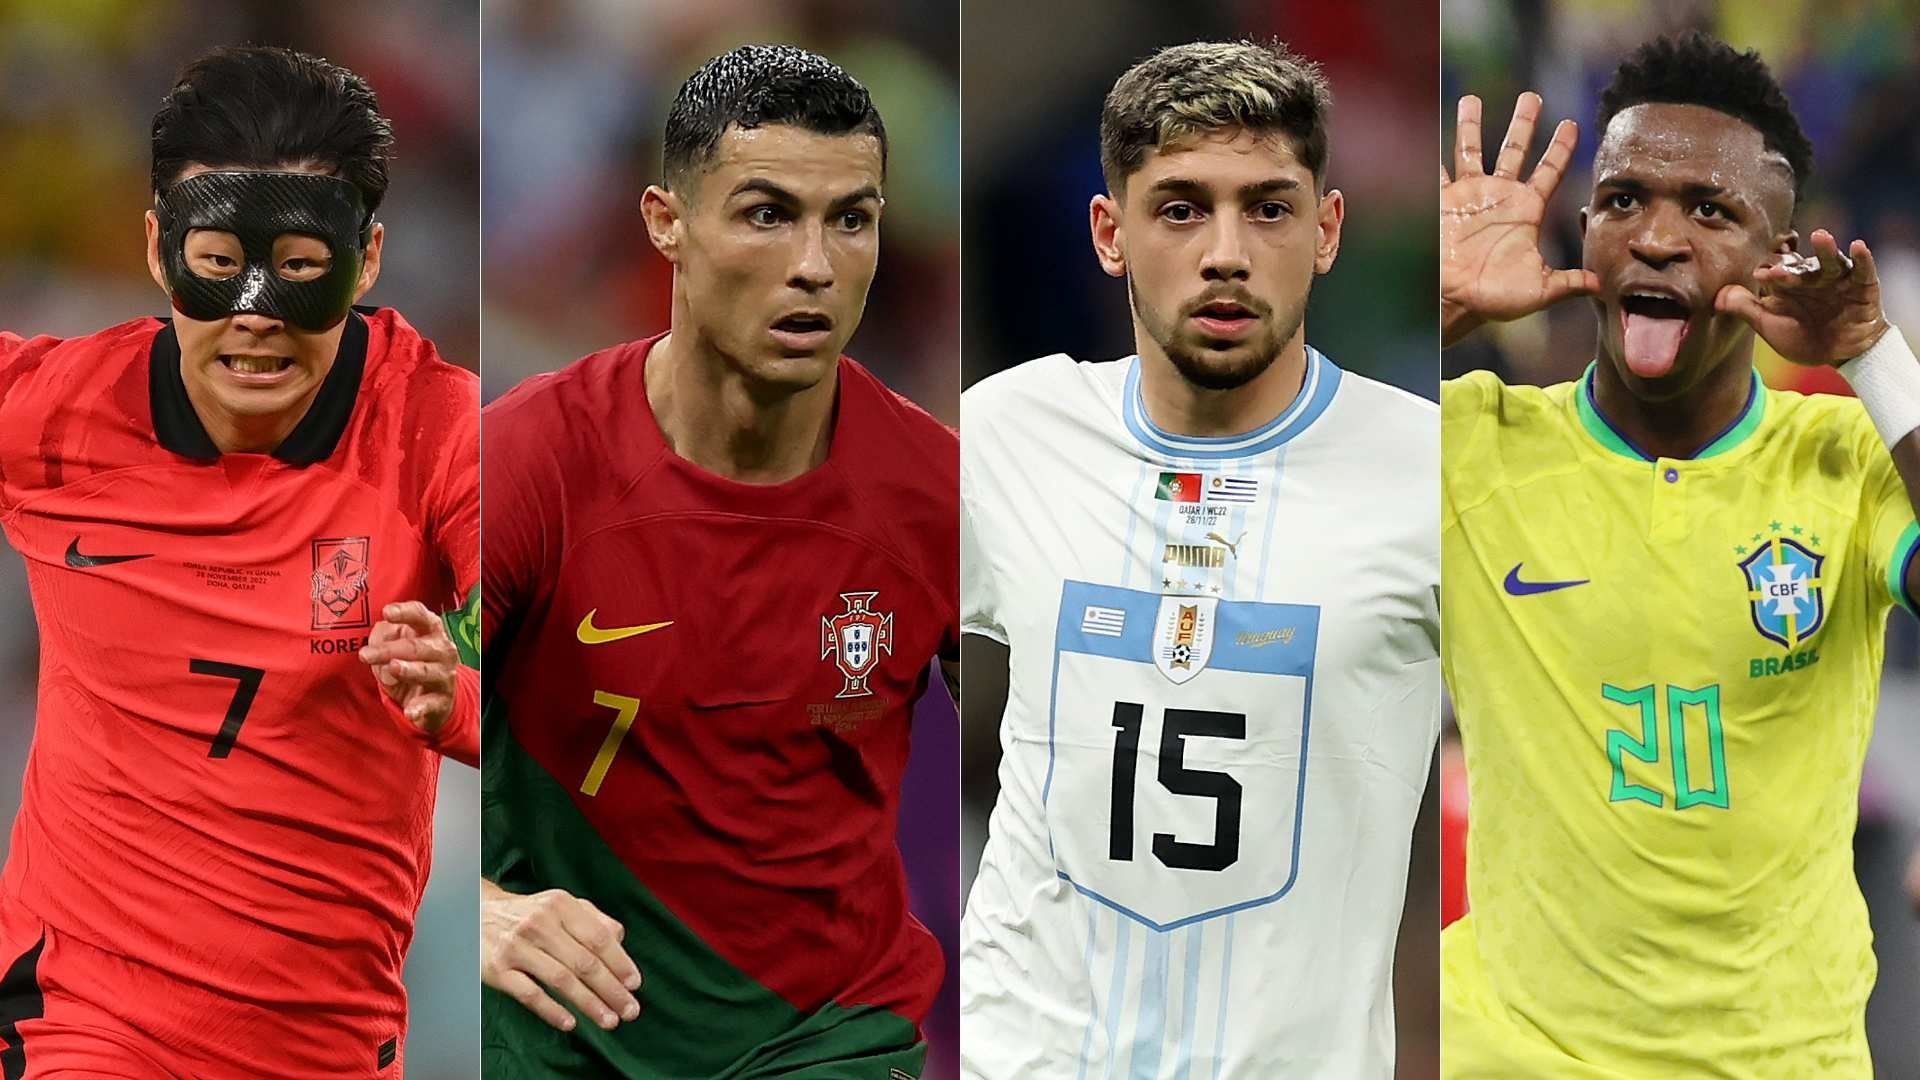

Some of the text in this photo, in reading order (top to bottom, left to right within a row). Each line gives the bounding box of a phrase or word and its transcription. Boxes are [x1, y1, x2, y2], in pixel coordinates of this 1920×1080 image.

[1179, 505, 1201, 515] QATAR
[1206, 507, 1227, 517] WC22
[1162, 544, 1226, 568] PUMA
[207, 573, 248, 582] NOVEMBER
[1770, 583, 1799, 597] CBF
[1178, 611, 1194, 642] AUF
[188, 658, 265, 759] 7
[580, 690, 641, 797] 7
[1602, 682, 1729, 811] 20
[1108, 701, 1248, 873] 15
